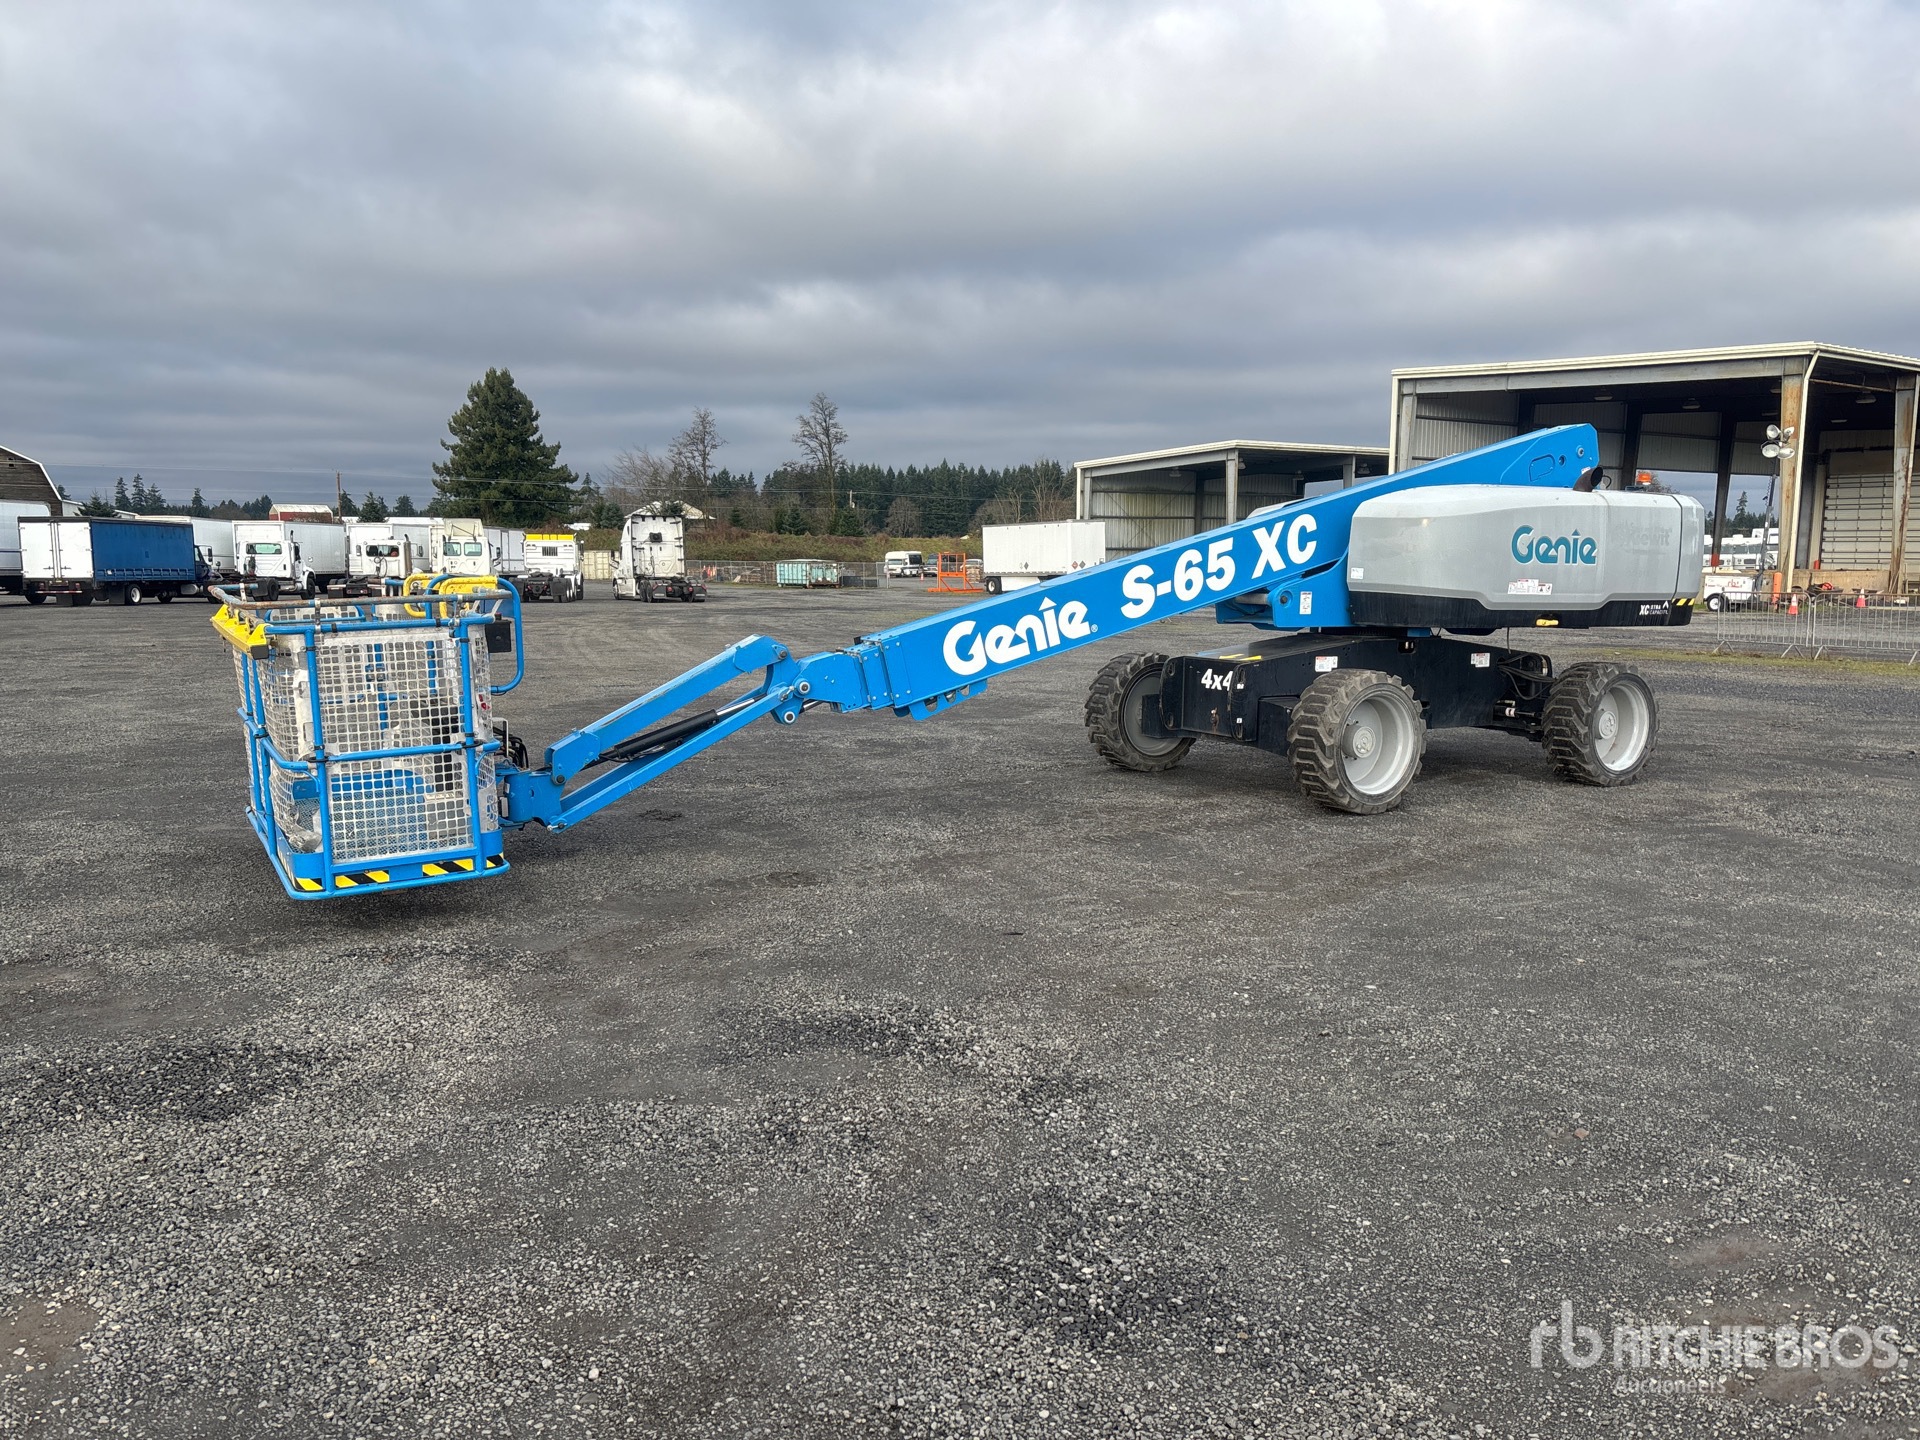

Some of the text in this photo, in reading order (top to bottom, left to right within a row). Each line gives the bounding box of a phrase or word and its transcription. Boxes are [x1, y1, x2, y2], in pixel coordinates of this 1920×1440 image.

[1511, 524, 1597, 565] Genie
[1120, 537, 1236, 619] S-65
[1251, 513, 1318, 580] XC
[1639, 604, 1650, 616] XC
[1201, 668, 1233, 691] 4x4
